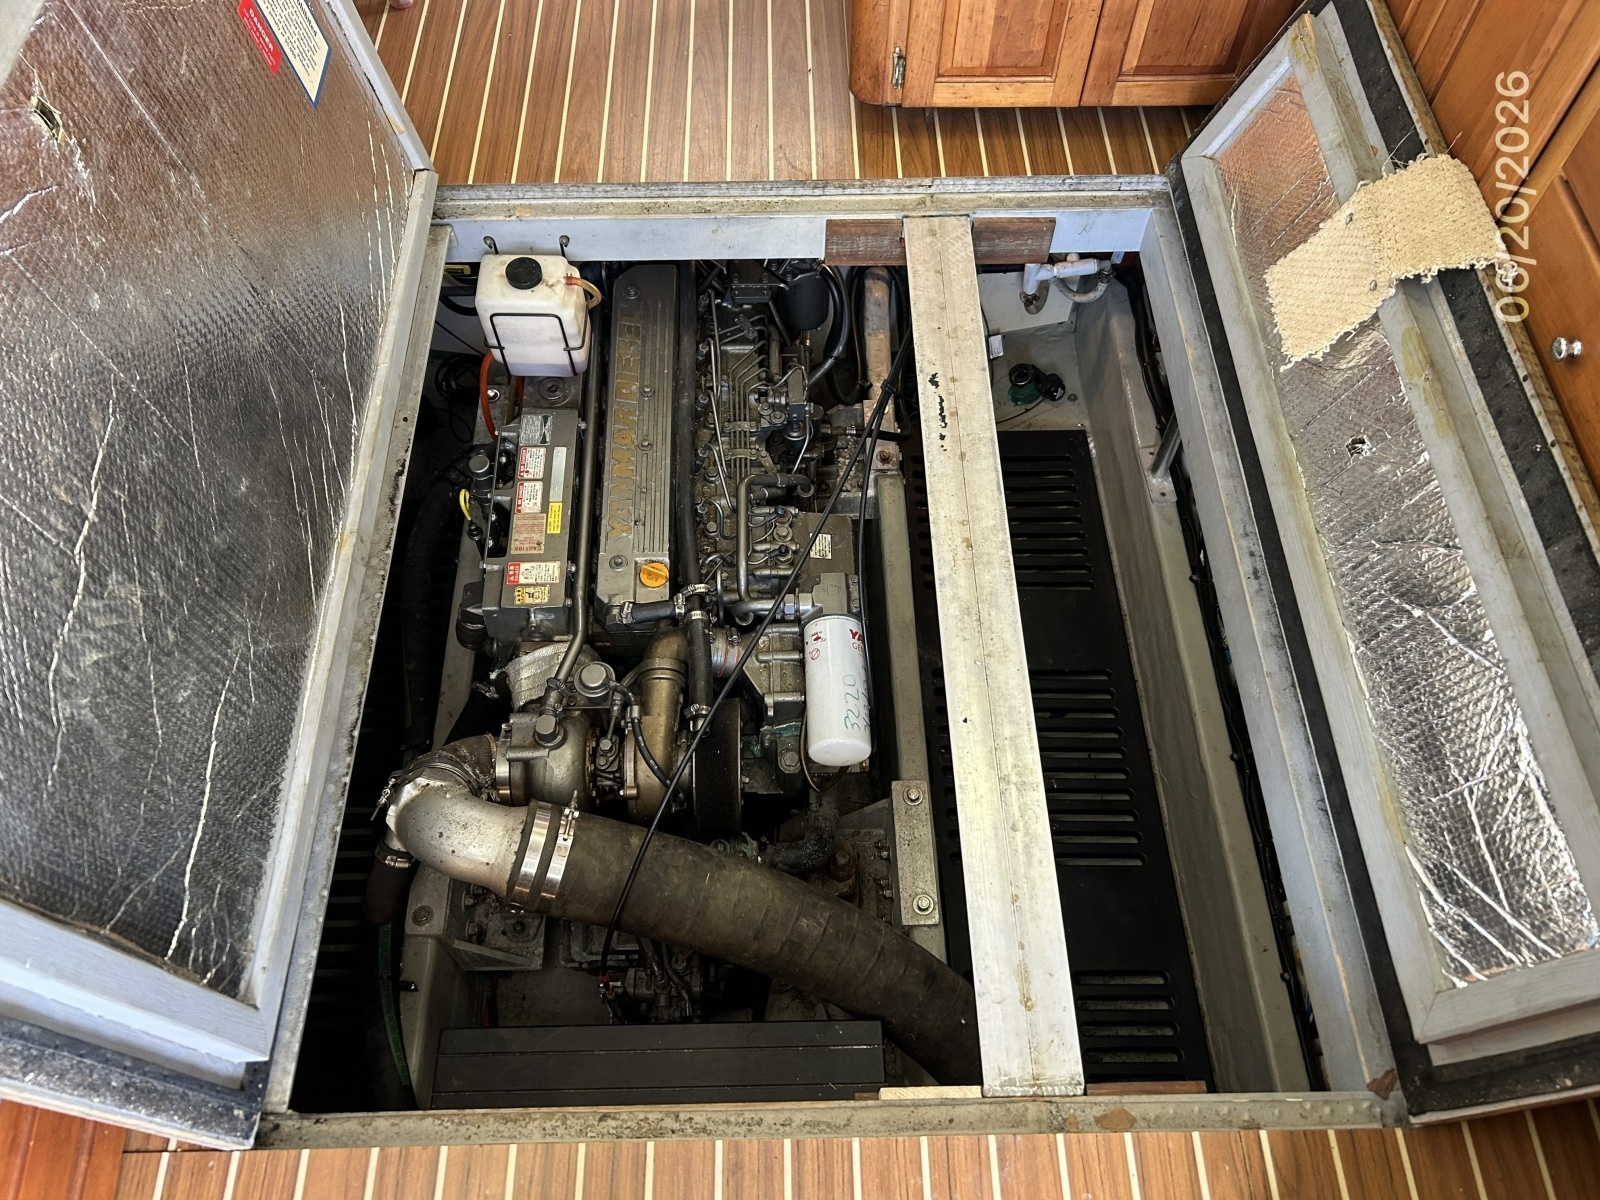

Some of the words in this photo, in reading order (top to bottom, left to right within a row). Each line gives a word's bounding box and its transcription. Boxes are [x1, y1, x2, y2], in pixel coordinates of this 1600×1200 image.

[249, 8, 274, 52] DANGER
[614, 311, 641, 403] DIESEL
[607, 406, 638, 541] YANMAR
[842, 674, 861, 731] 3220
